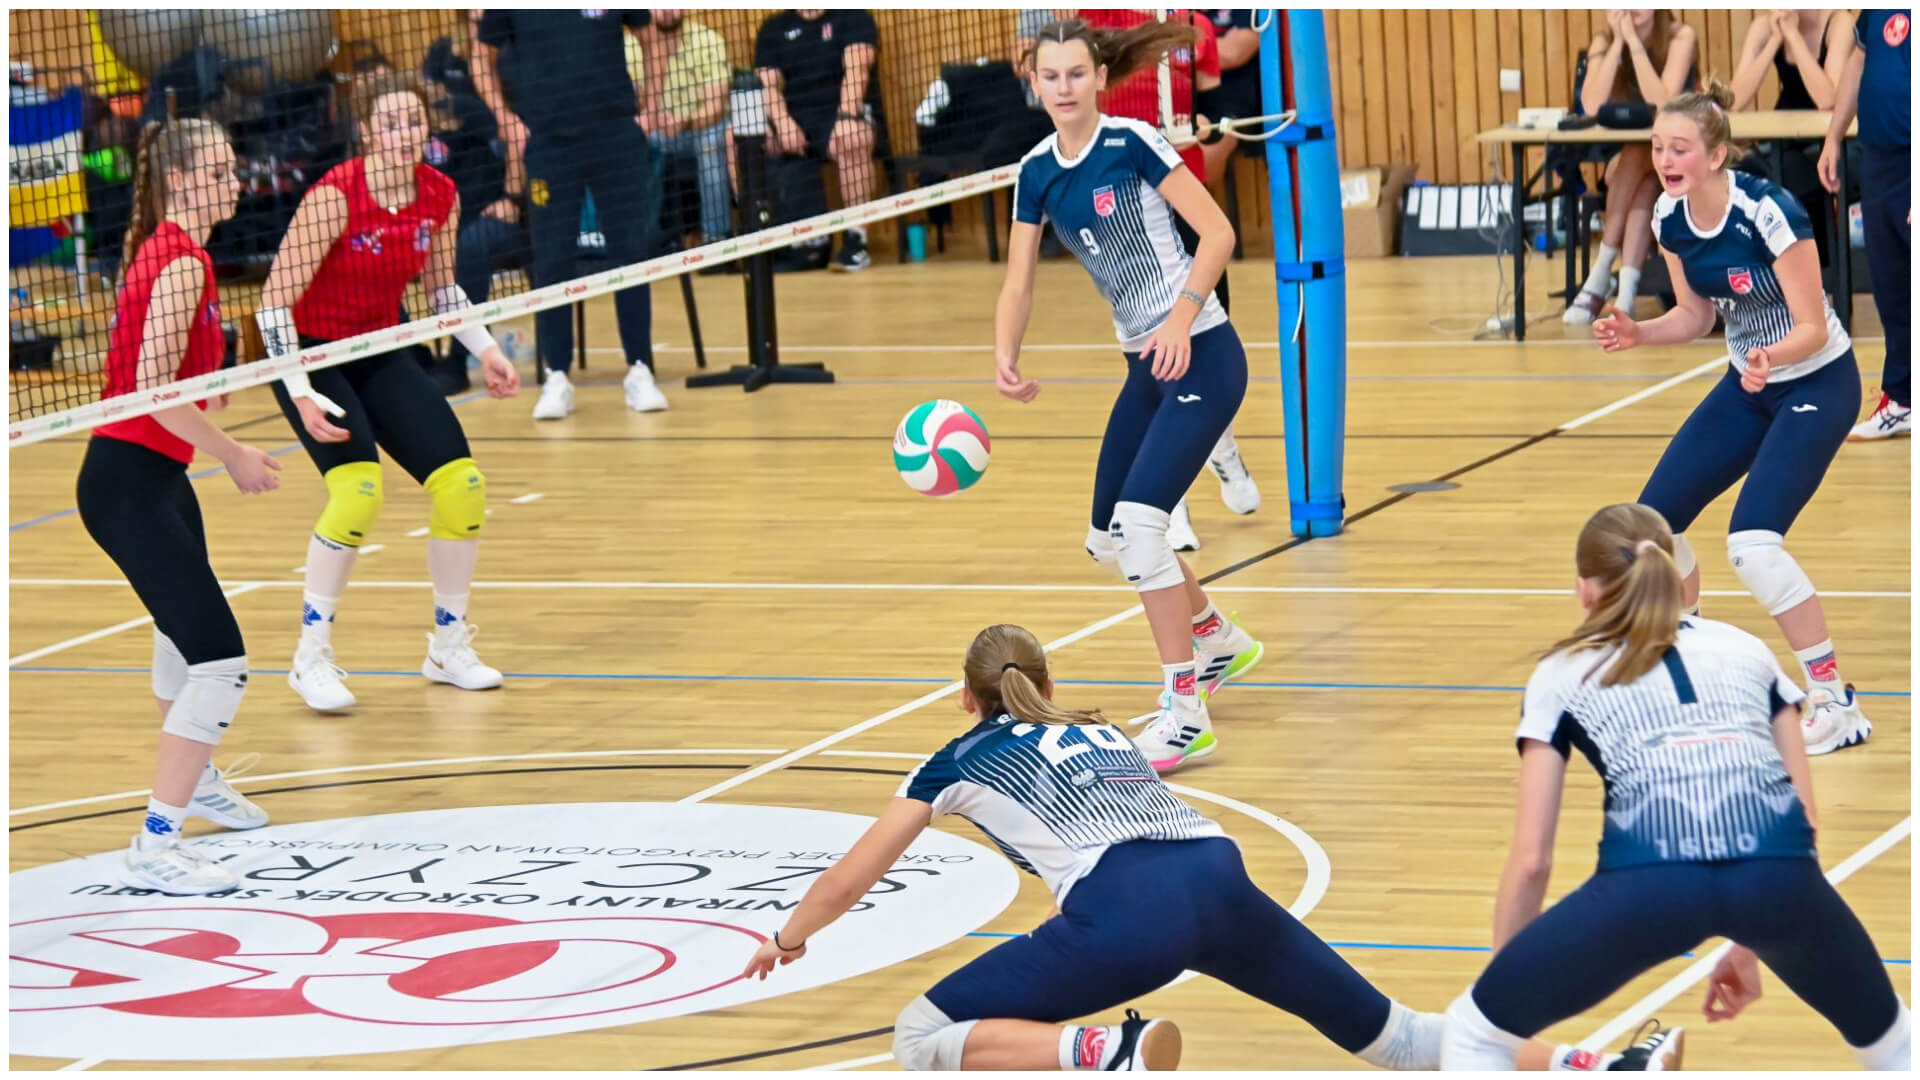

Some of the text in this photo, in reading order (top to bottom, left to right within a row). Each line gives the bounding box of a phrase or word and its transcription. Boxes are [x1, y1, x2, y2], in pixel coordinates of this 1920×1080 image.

[1078, 227, 1101, 256] 9
[780, 851, 974, 864] OŚRDEK
[210, 853, 942, 894] SZCZYR
[278, 888, 541, 907] OŚRODEK
[547, 895, 876, 912] CNTRALNY
